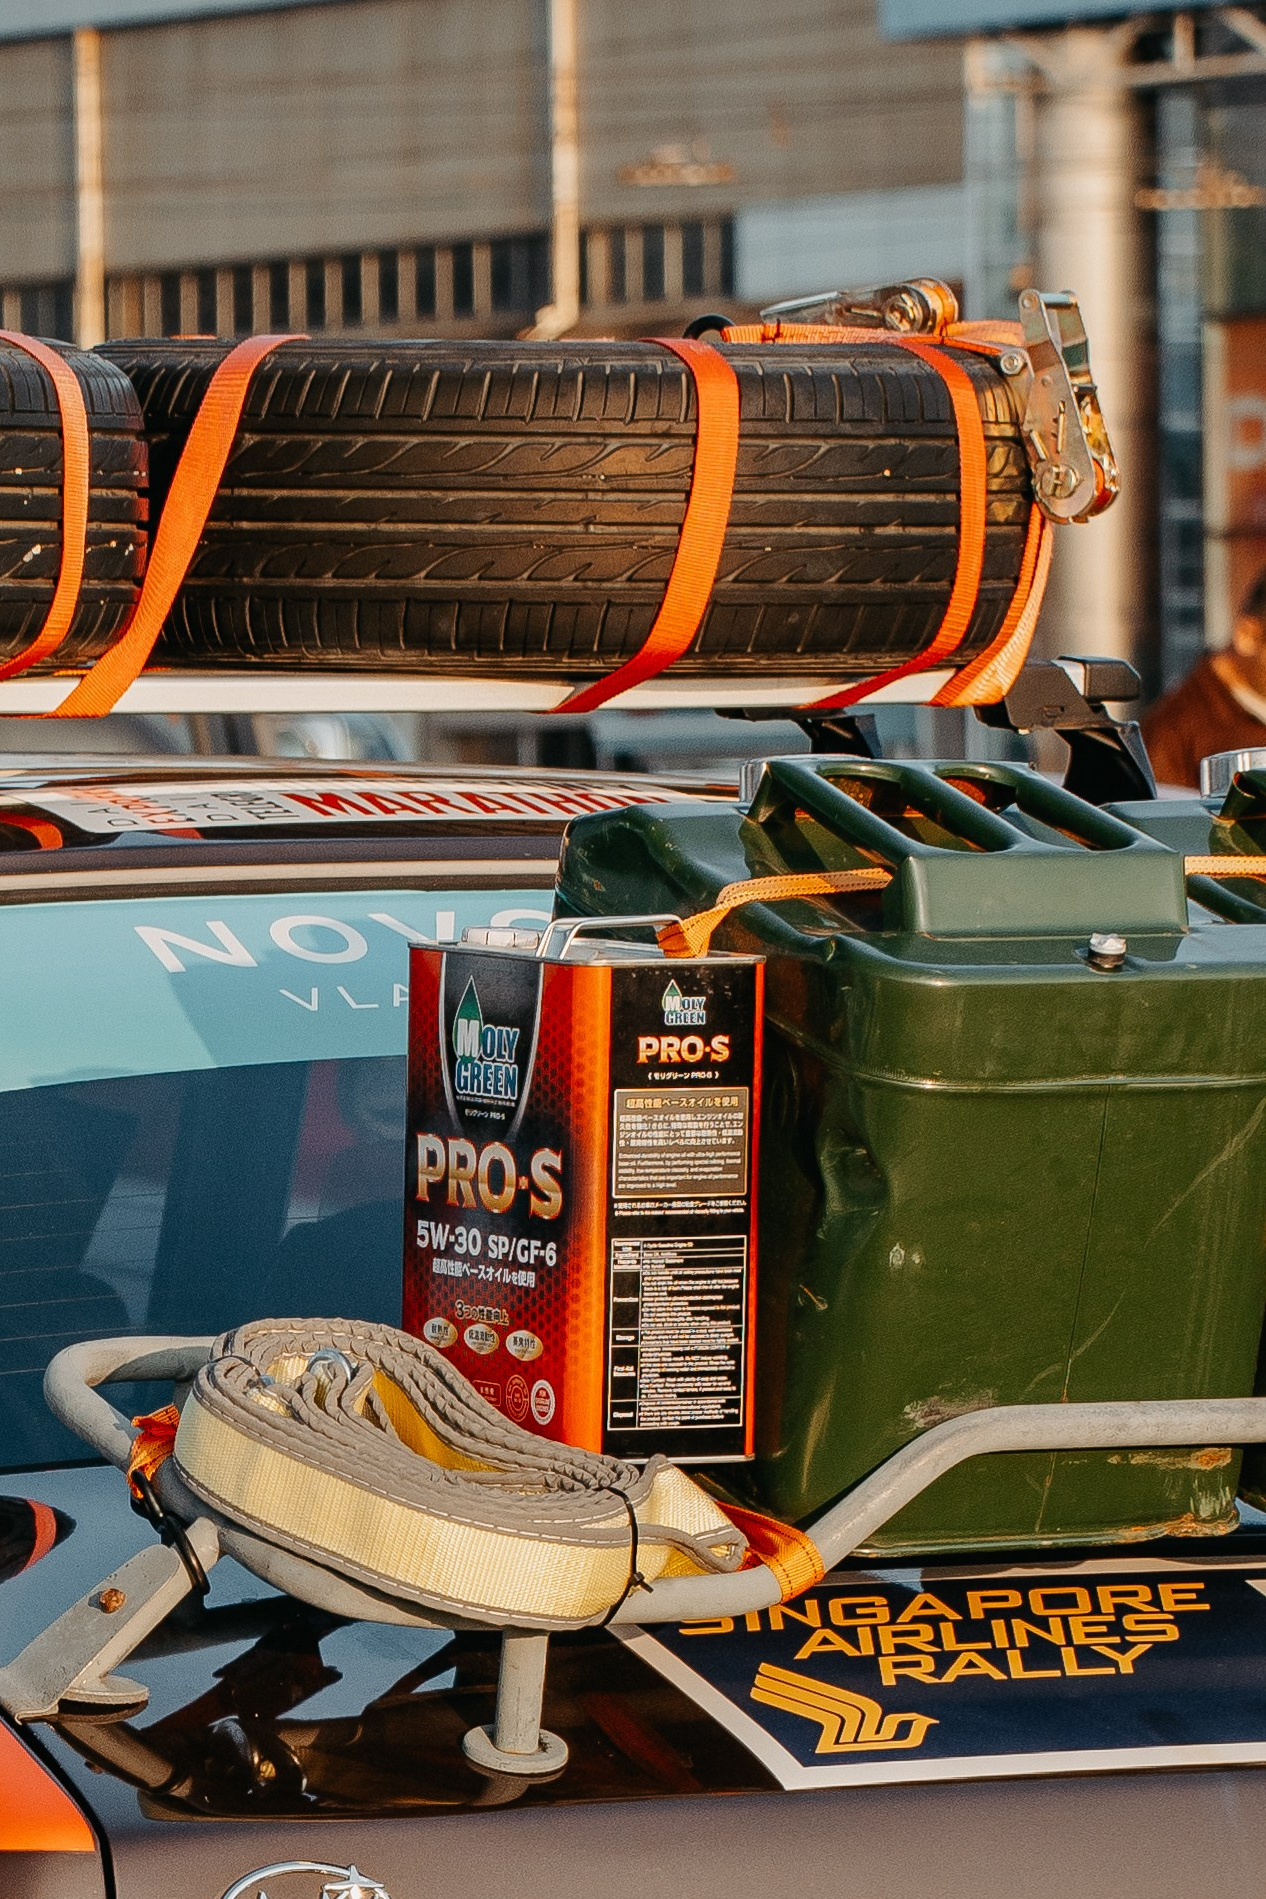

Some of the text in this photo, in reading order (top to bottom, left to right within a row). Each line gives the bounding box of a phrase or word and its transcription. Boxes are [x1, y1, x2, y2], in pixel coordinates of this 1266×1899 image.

[664, 1010, 706, 1026] GREEN
[665, 996, 706, 1012] MOLY
[457, 1018, 520, 1062] MOLY
[455, 1060, 518, 1099] GREEN
[416, 1219, 557, 1267] 5W-30 SP/GF-6
[795, 1613, 1179, 1660] AIRLINES
[878, 1643, 1153, 1687] RALLY
